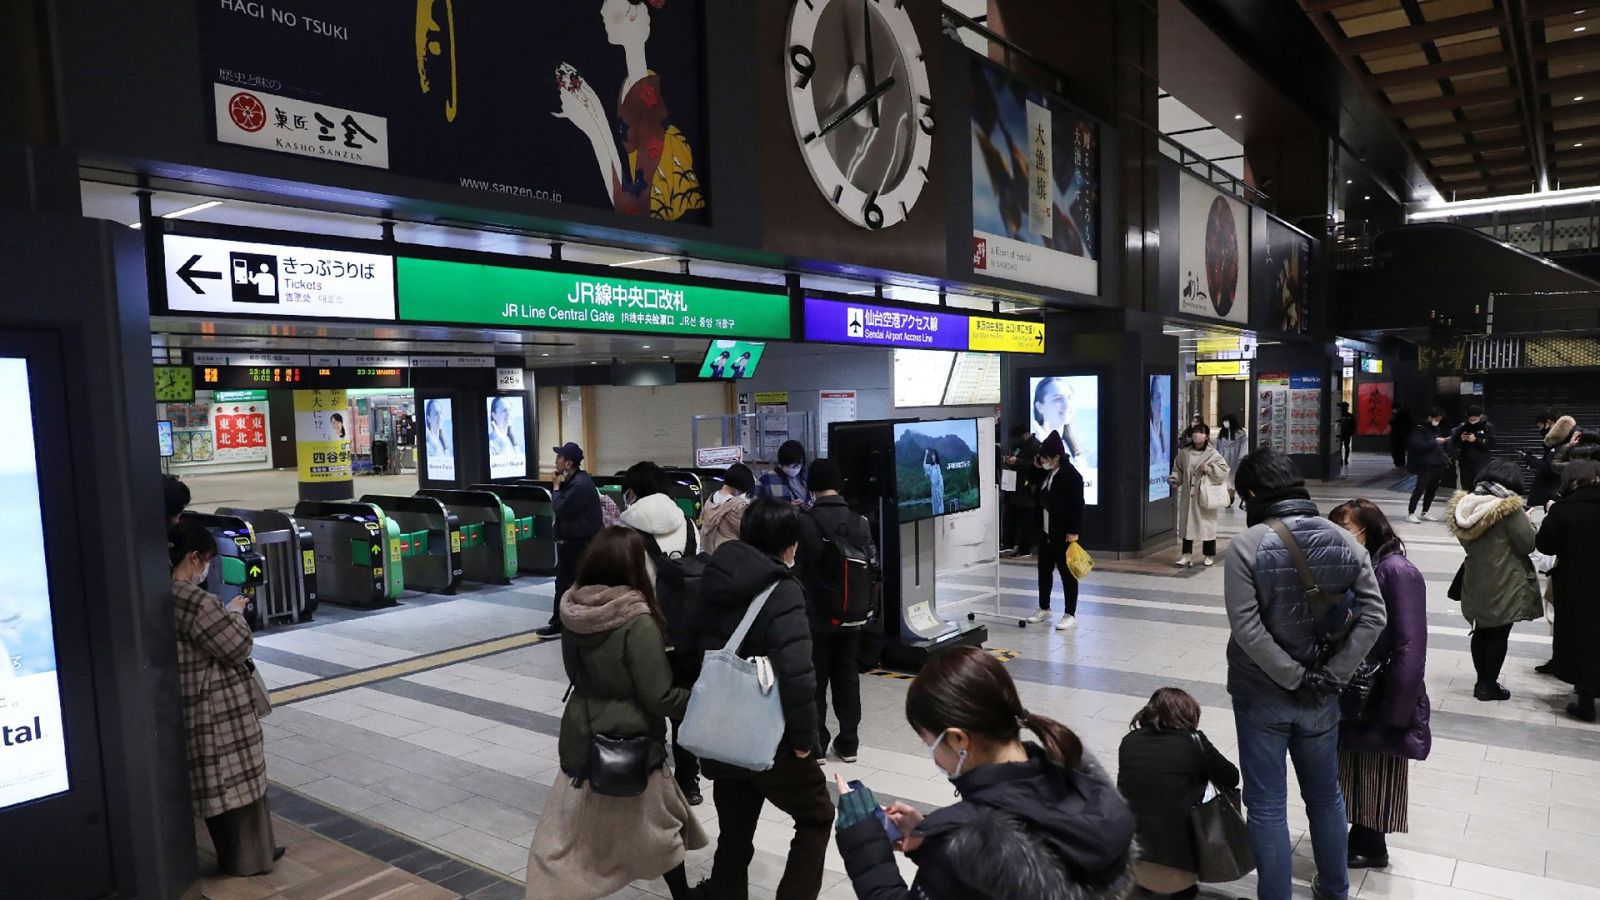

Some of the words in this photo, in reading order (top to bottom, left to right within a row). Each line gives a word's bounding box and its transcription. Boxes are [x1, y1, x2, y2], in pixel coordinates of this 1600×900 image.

[221, 0, 265, 19] HAGI
[271, 8, 297, 27] NO
[302, 16, 349, 41] TSUKI
[790, 44, 816, 90] 9
[918, 94, 936, 136] 3
[275, 137, 316, 153] KASHO
[319, 145, 363, 161] SANZEN
[864, 189, 884, 230] 6
[282, 256, 376, 280] きっぷうりば
[284, 278, 323, 291] Tickets
[568, 282, 688, 311] JR線中央口改札
[501, 303, 519, 318] JR
[521, 304, 546, 319] Line
[548, 306, 589, 321] Central
[590, 308, 615, 323] Gate
[864, 309, 938, 332] 仙台空港アクセス線
[864, 328, 885, 340] Sendai
[885, 330, 904, 343] Airport
[904, 331, 921, 343] Access
[921, 333, 933, 343] Line
